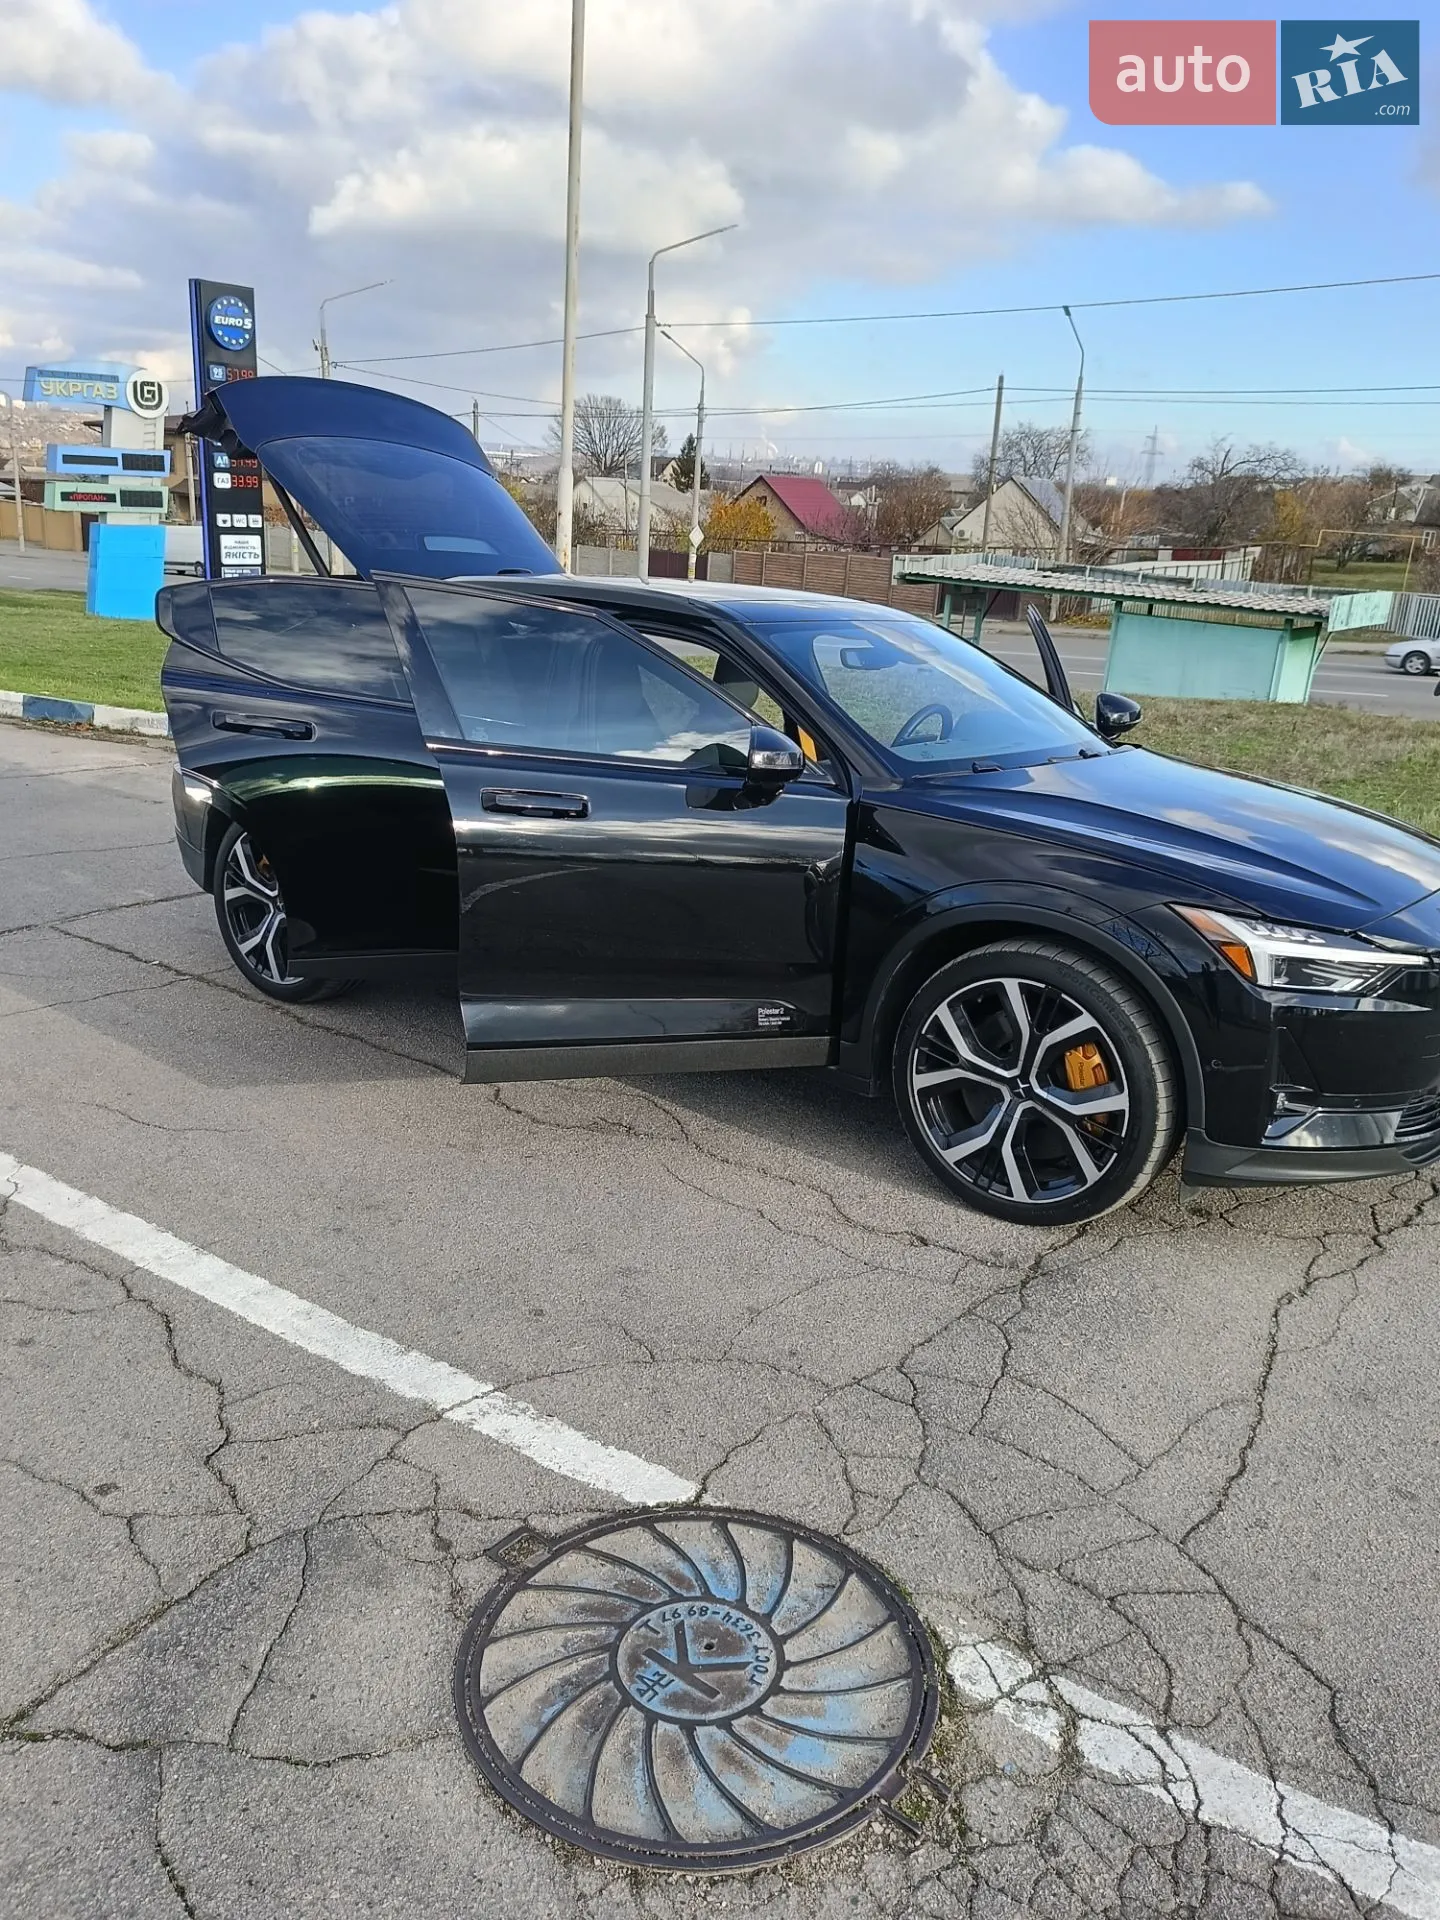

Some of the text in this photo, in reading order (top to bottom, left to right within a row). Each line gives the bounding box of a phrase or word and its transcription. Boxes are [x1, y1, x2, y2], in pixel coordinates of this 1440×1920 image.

[226, 368, 254, 381] 5799
[41, 379, 120, 400] УКРГАЗ
[232, 475, 259, 488] 33.99
[224, 551, 260, 559] ЯКІСТЬ
[687, 1605, 762, 1642] 3634-89
[749, 1645, 771, 1687] ГОСТ
